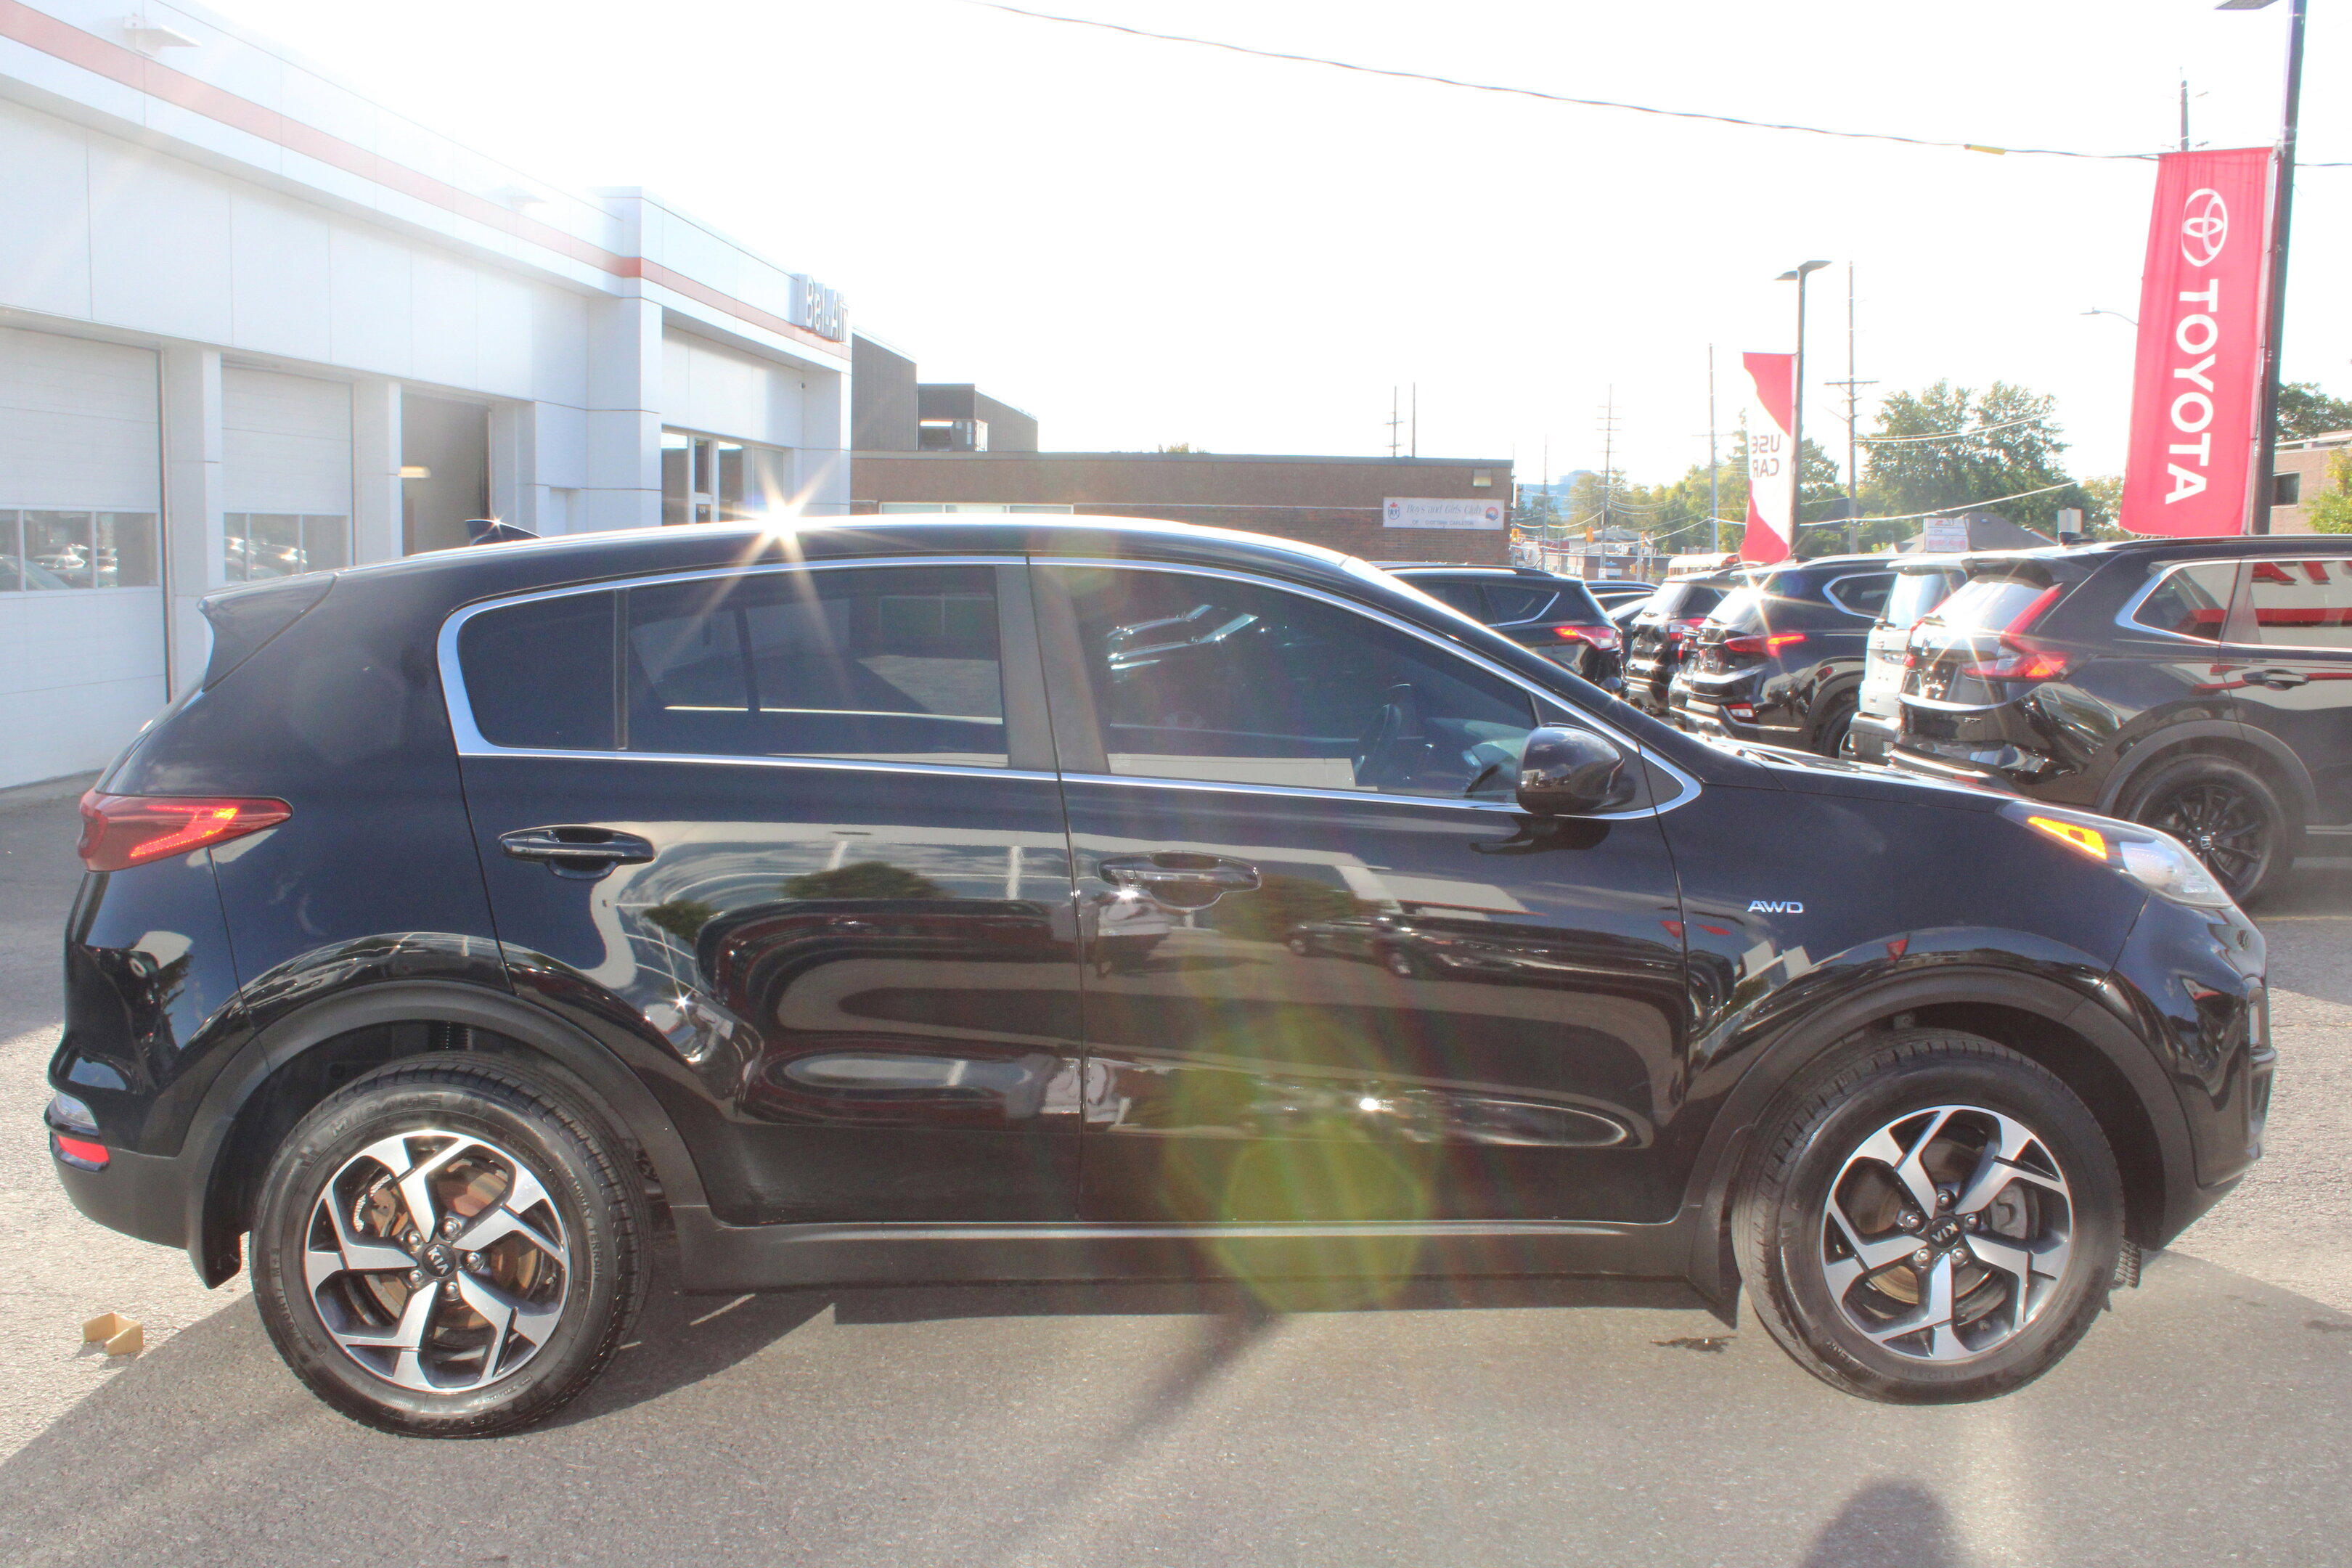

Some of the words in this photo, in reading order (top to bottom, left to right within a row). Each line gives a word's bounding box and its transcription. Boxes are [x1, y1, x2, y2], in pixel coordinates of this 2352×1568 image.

[2165, 279, 2218, 505] TOYOTA
[1747, 900, 1804, 914] AWD
[1931, 1222, 1959, 1242] KIA
[428, 1245, 449, 1275] KIA
